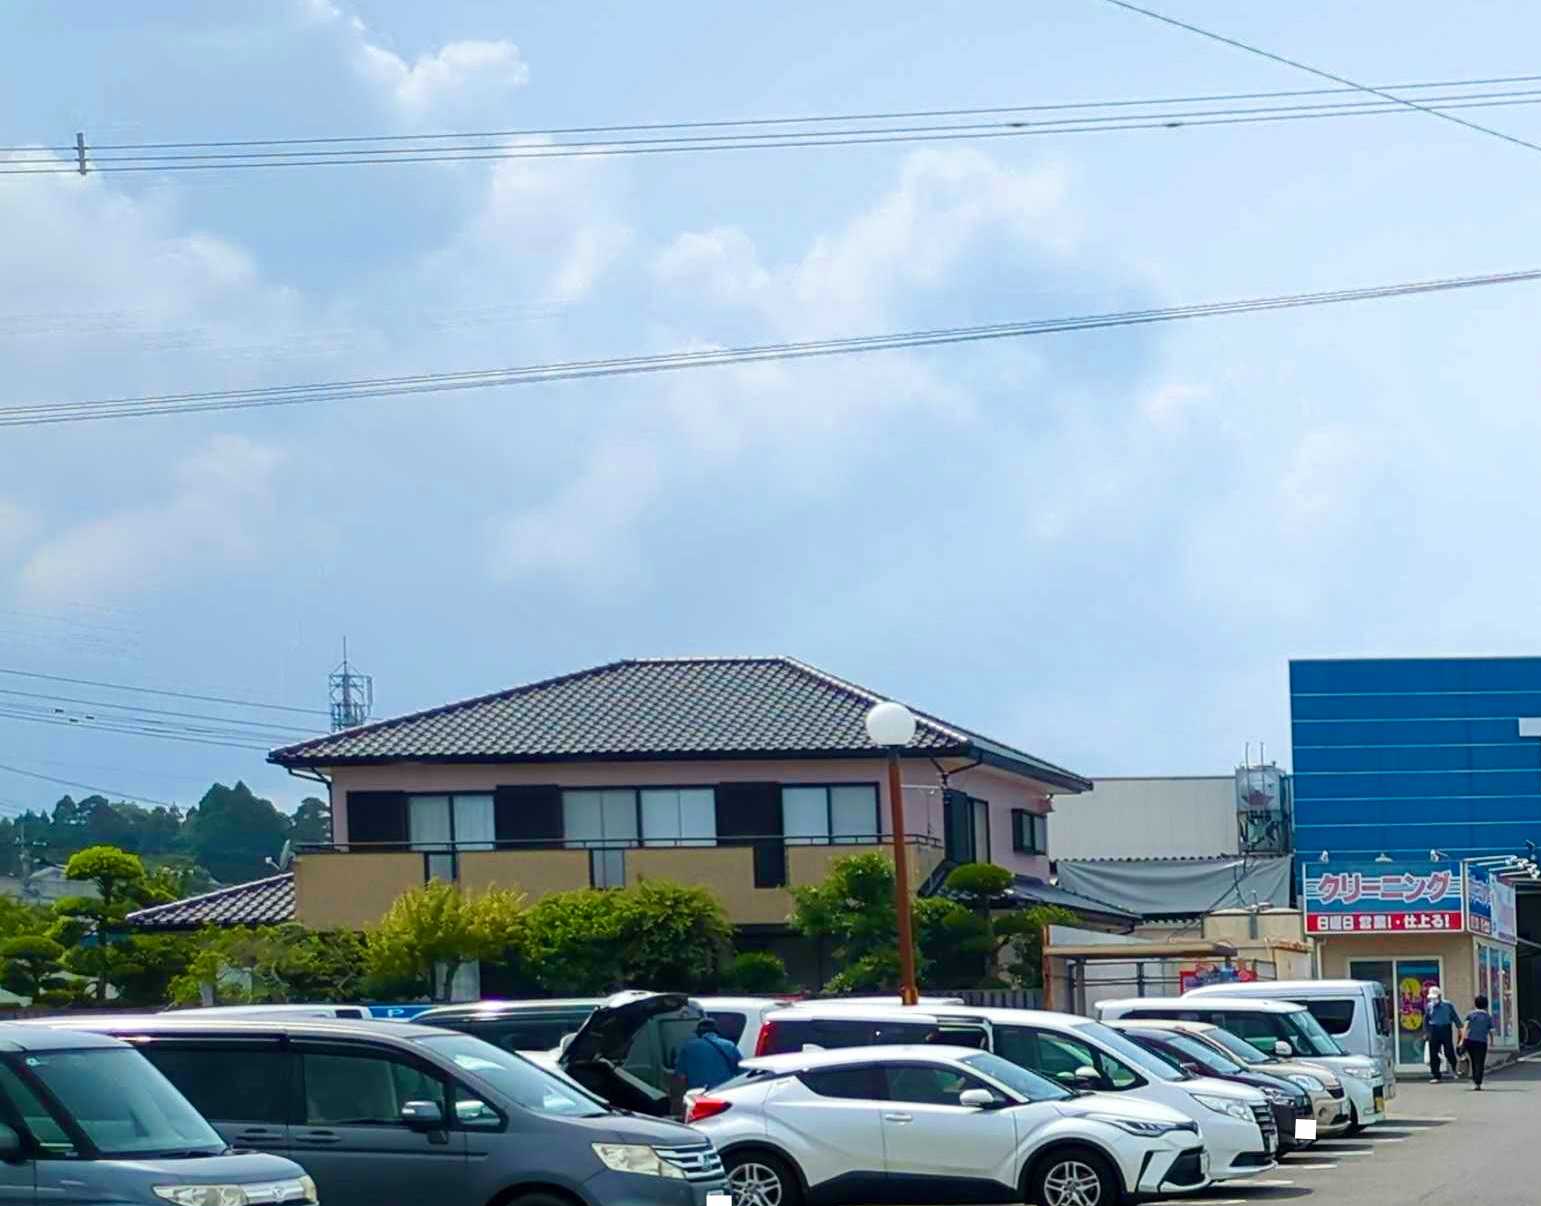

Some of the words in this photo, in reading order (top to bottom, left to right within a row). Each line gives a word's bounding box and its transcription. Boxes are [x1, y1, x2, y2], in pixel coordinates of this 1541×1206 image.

[1318, 869, 1452, 905] クリーニング
